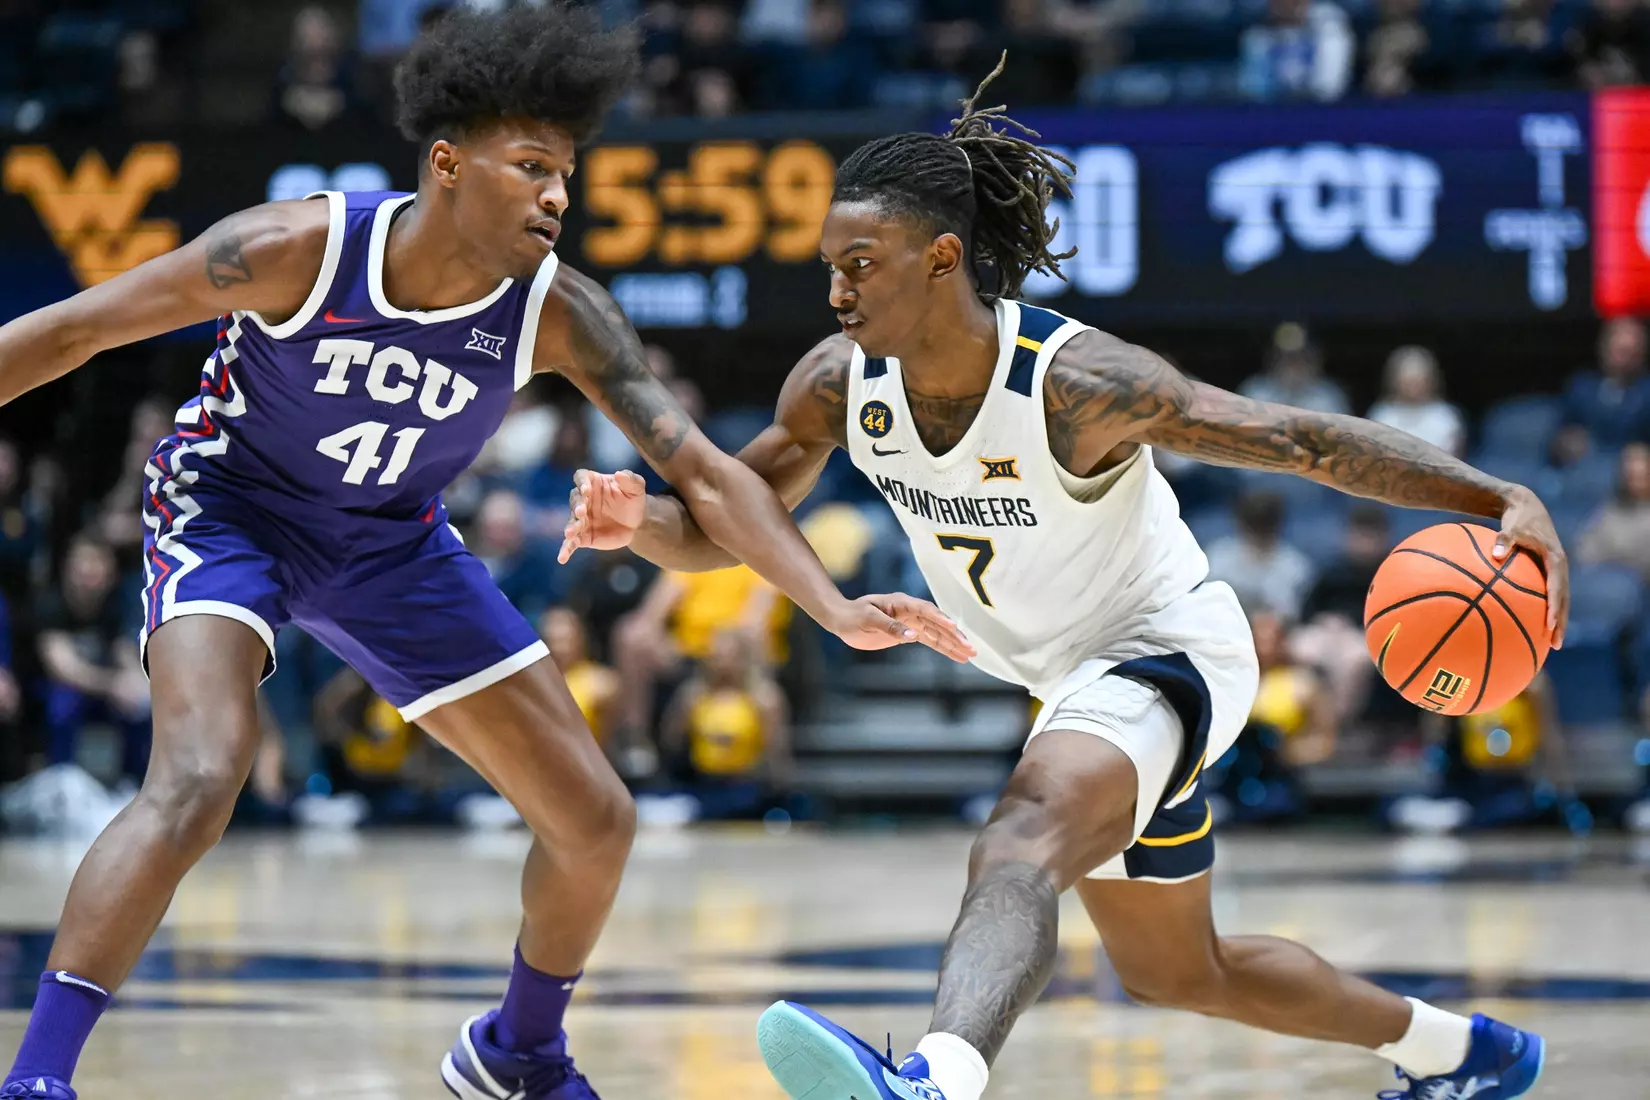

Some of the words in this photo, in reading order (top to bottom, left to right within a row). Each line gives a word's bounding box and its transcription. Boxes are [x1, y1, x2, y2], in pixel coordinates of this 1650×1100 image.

[580, 140, 836, 267] 5:59
[1207, 142, 1442, 275] TCU
[312, 339, 479, 421] TCU
[867, 406, 887, 416] WEST
[316, 420, 426, 486] 41
[863, 413, 885, 432] 44
[876, 474, 1038, 527] MOUNTAINEERS
[934, 533, 996, 609] 7
